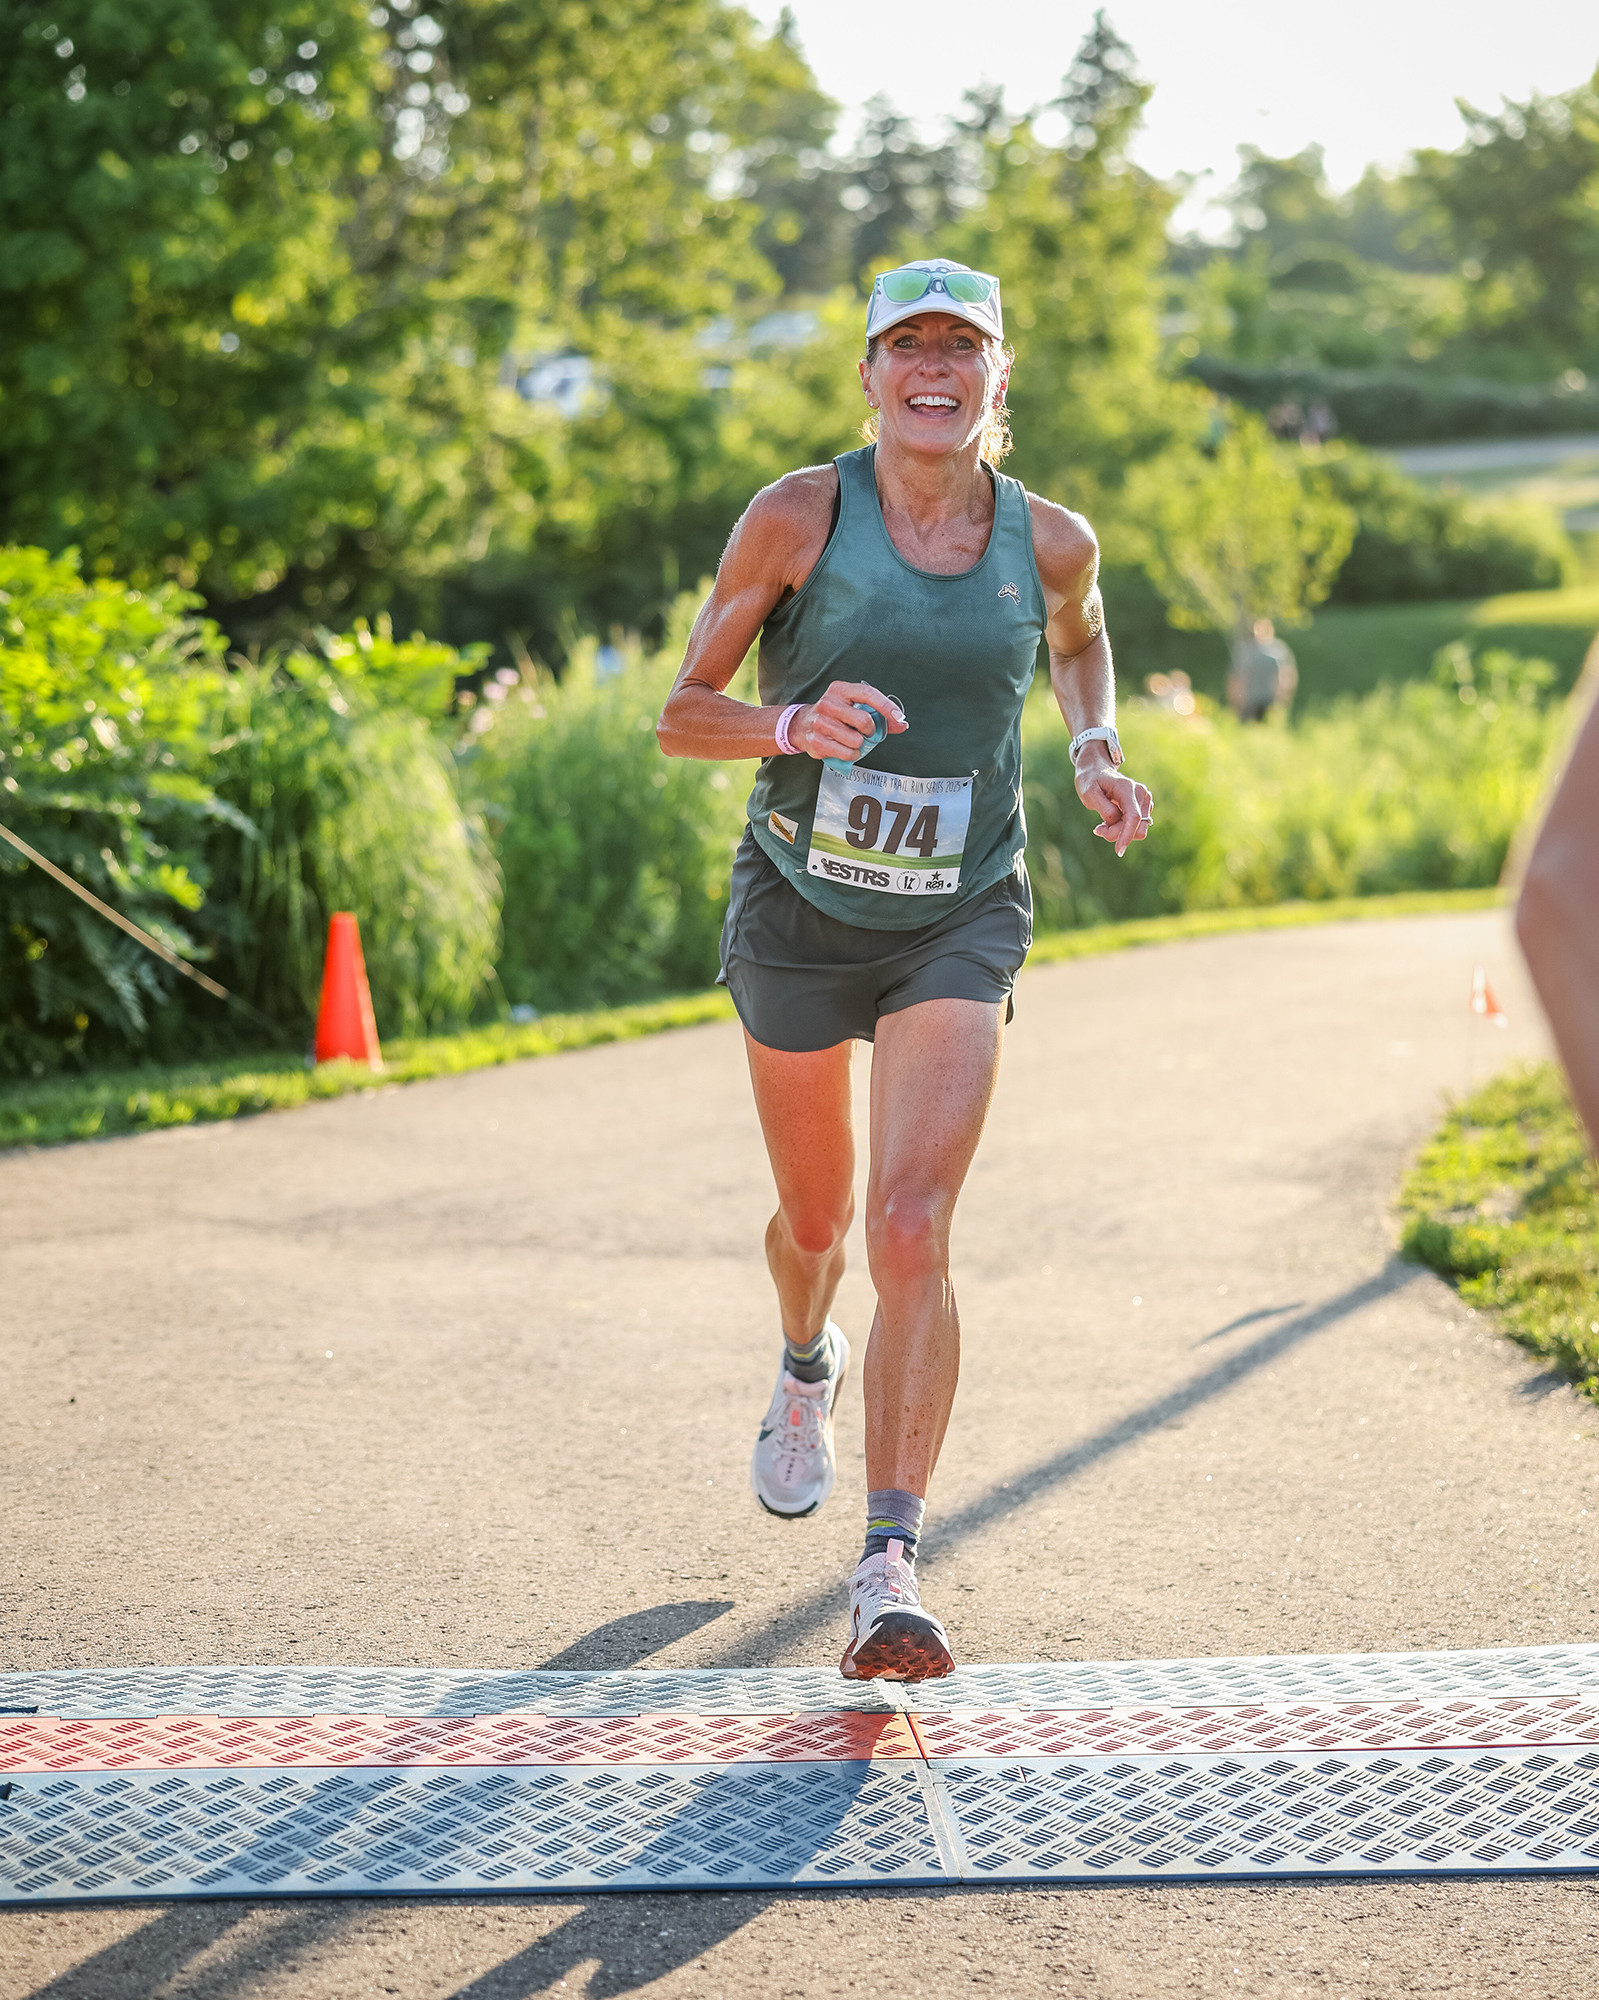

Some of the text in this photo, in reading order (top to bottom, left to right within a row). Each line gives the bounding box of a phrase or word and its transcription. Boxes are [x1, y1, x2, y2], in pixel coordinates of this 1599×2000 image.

[862, 771, 888, 788] SUMMER
[890, 777, 908, 792] TRAIL
[910, 780, 924, 794] RUN
[926, 781, 944, 794] SERIES
[945, 780, 961, 793] 2025
[845, 795, 940, 857] 974
[828, 860, 890, 887] ESTRS
